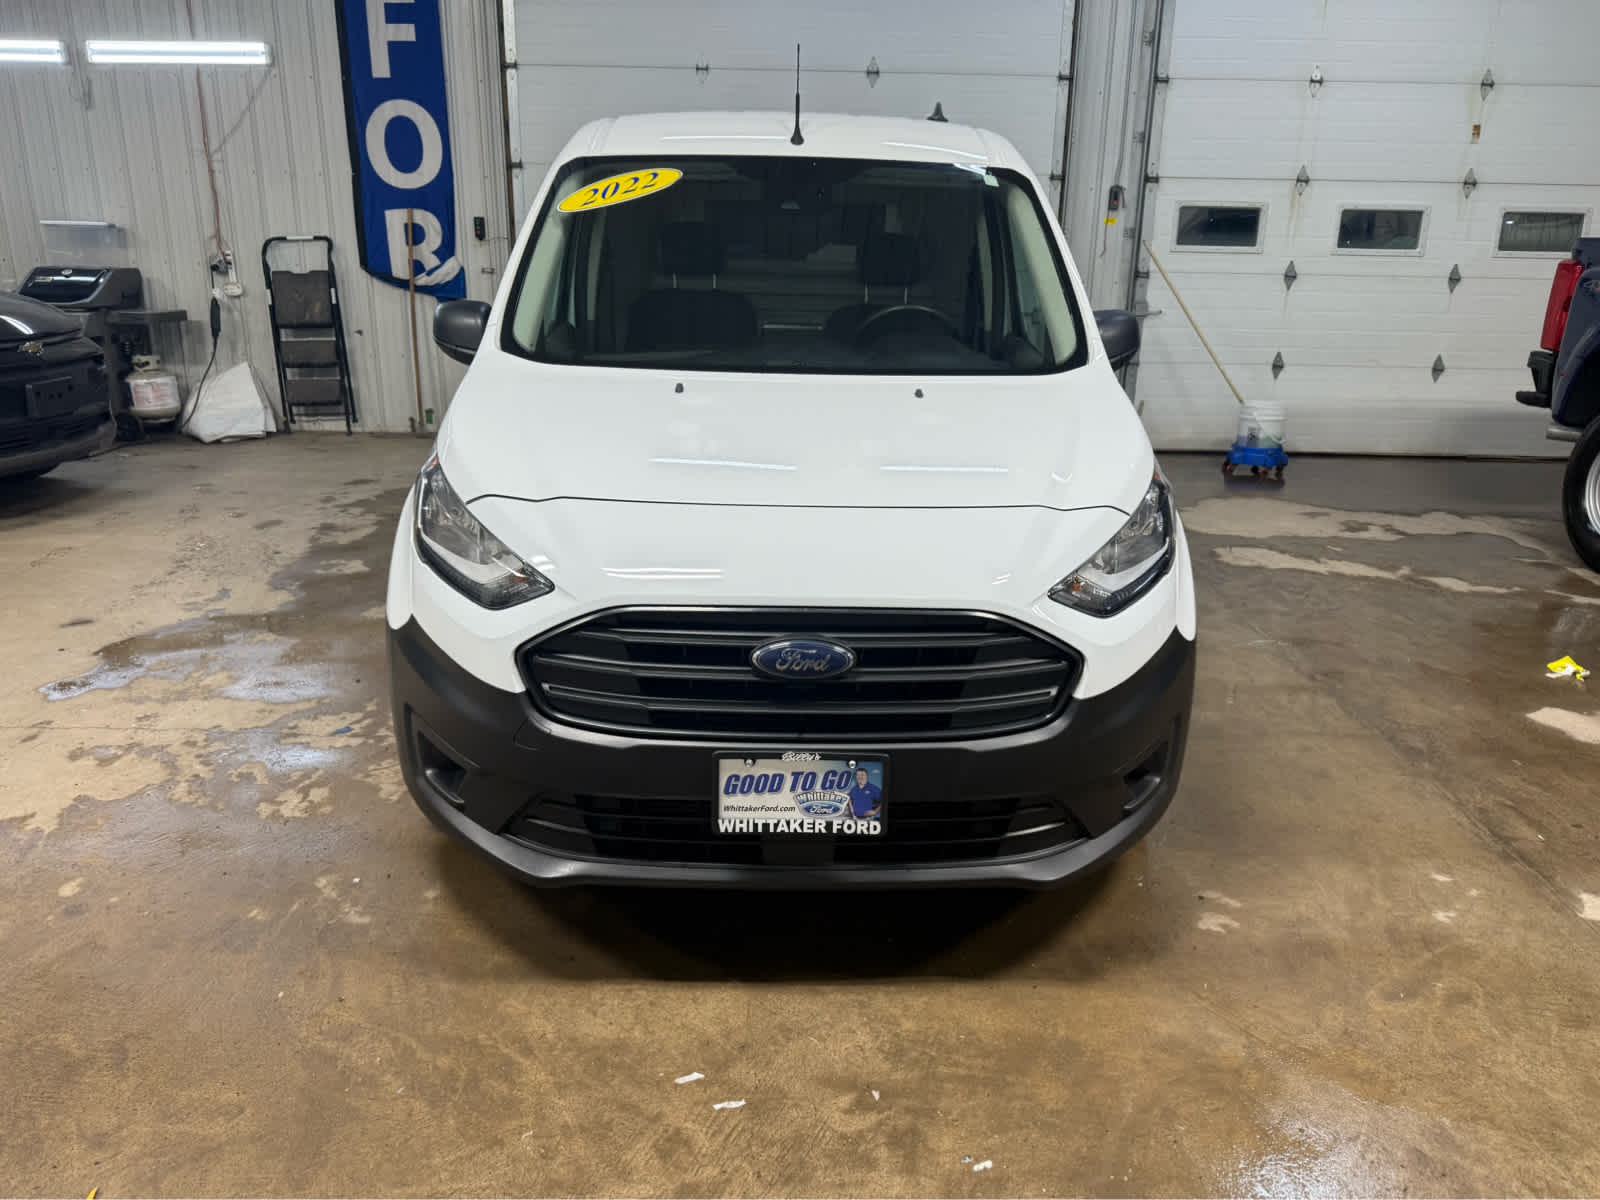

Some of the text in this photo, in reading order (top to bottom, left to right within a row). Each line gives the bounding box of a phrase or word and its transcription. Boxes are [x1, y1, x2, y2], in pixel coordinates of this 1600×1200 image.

[581, 172, 659, 206] 2022
[776, 648, 831, 671] Ford
[723, 770, 853, 795] GOOD TO GO
[796, 791, 848, 804] Whittaker
[723, 804, 796, 813] WhittakerFord.com
[810, 806, 834, 815] Ford
[718, 818, 881, 835] WHITTAKER FORD
